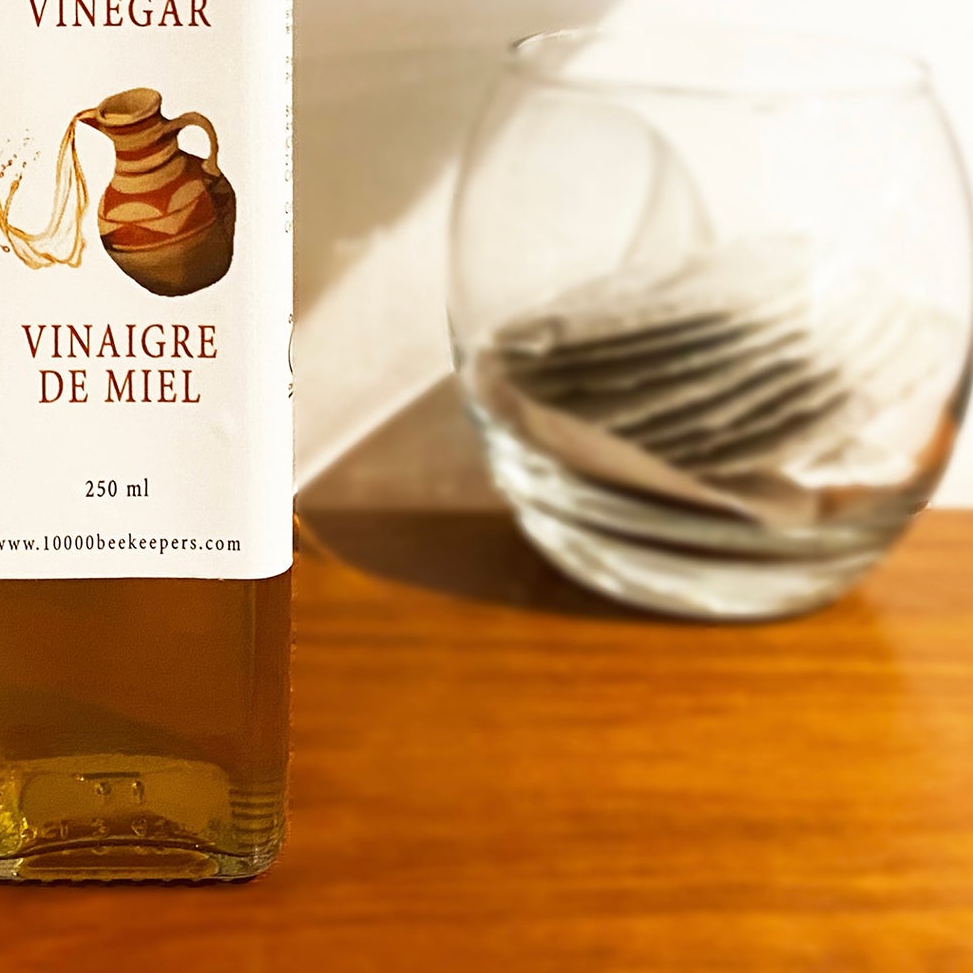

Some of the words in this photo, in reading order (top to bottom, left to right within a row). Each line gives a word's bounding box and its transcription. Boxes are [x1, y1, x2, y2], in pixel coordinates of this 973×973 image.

[21, 323, 218, 359] VINAIGRE
[38, 369, 89, 404] DE
[104, 369, 201, 404] MIEL
[85, 479, 118, 498] 250
[126, 477, 149, 498] ml
